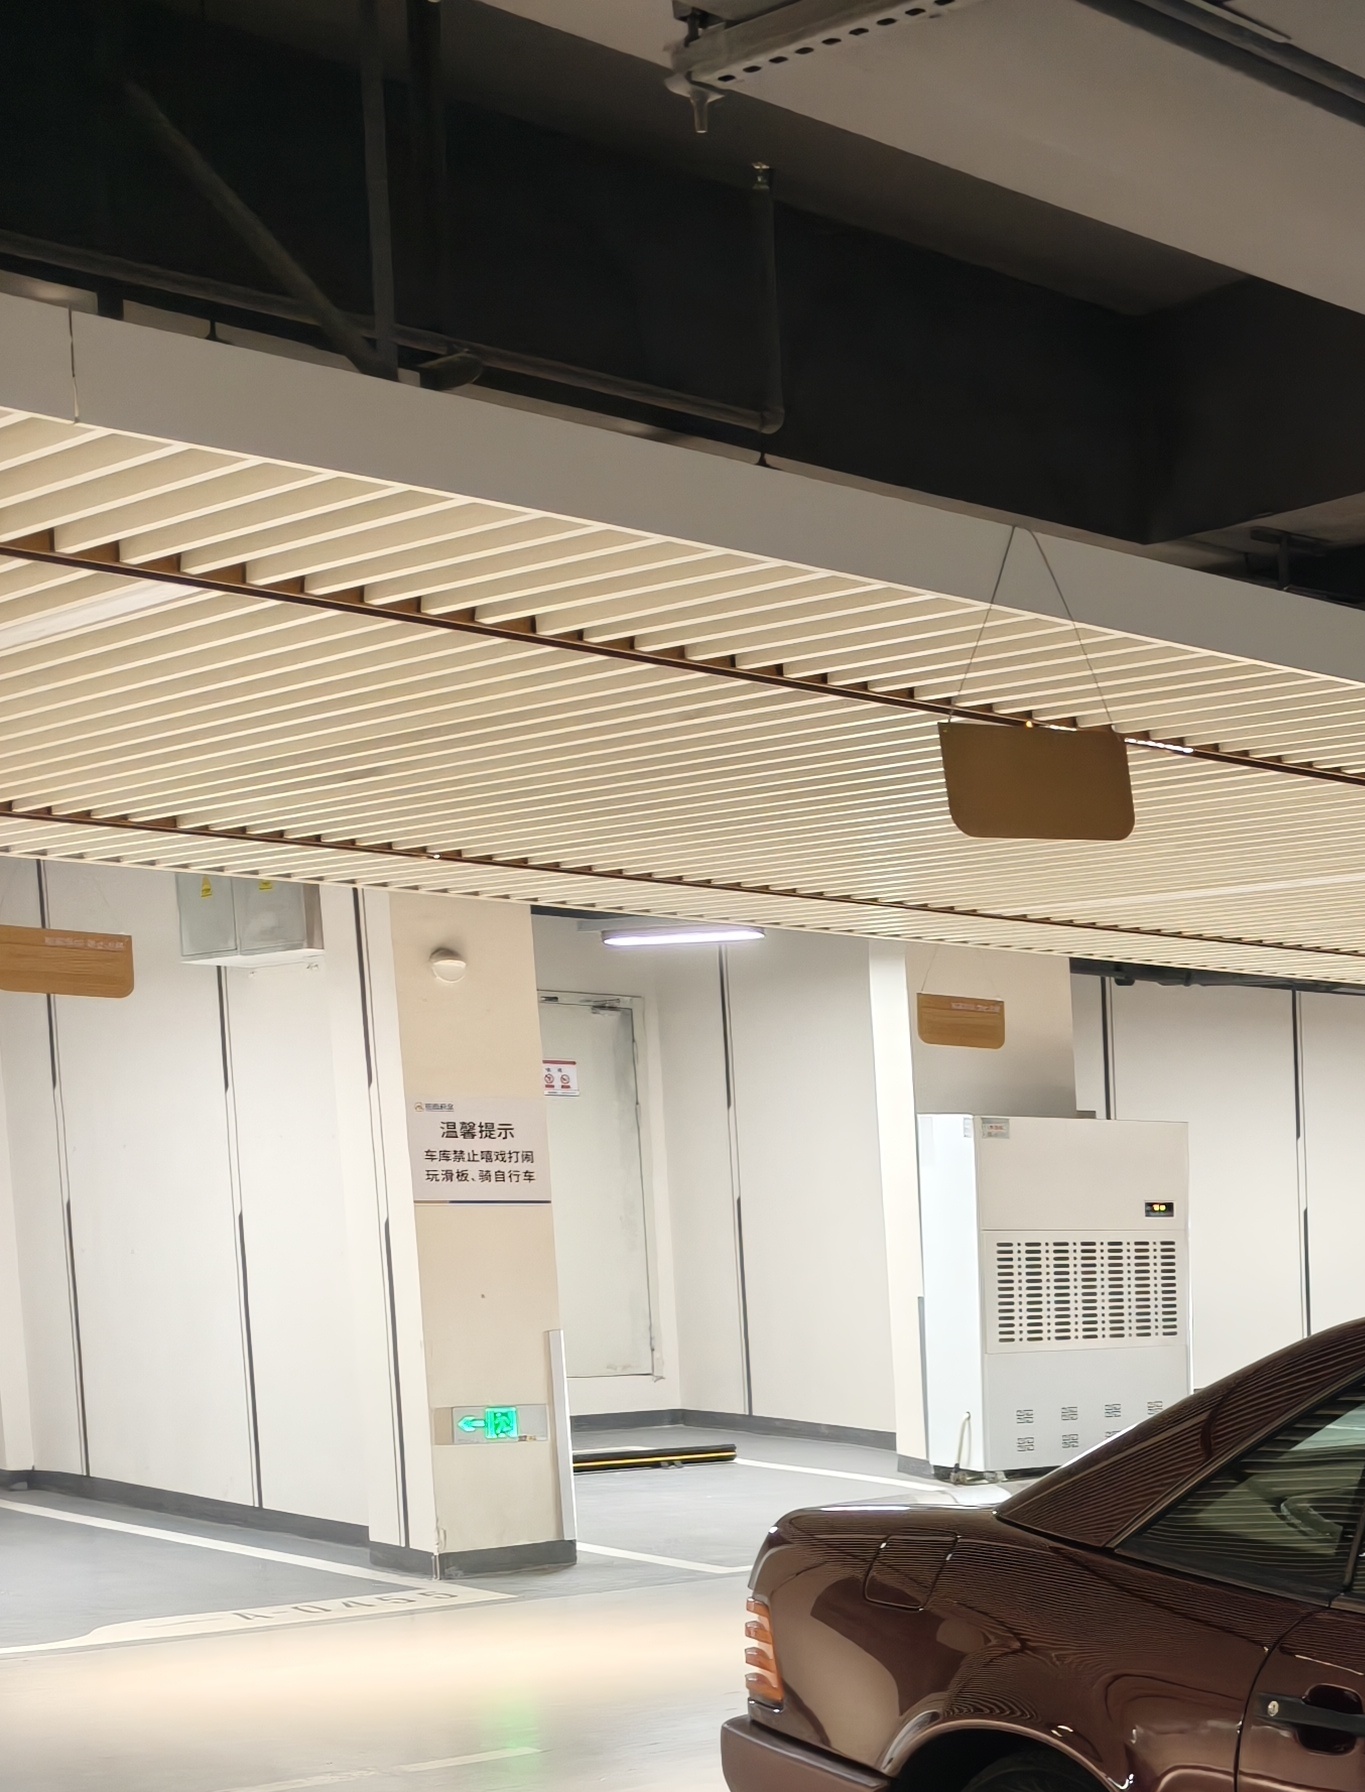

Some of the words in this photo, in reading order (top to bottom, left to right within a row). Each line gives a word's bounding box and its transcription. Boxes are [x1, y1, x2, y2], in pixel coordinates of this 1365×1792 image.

[440, 1121, 515, 1140] 温馨提示
[425, 1169, 536, 1184] 玩滑板、骑自行车
